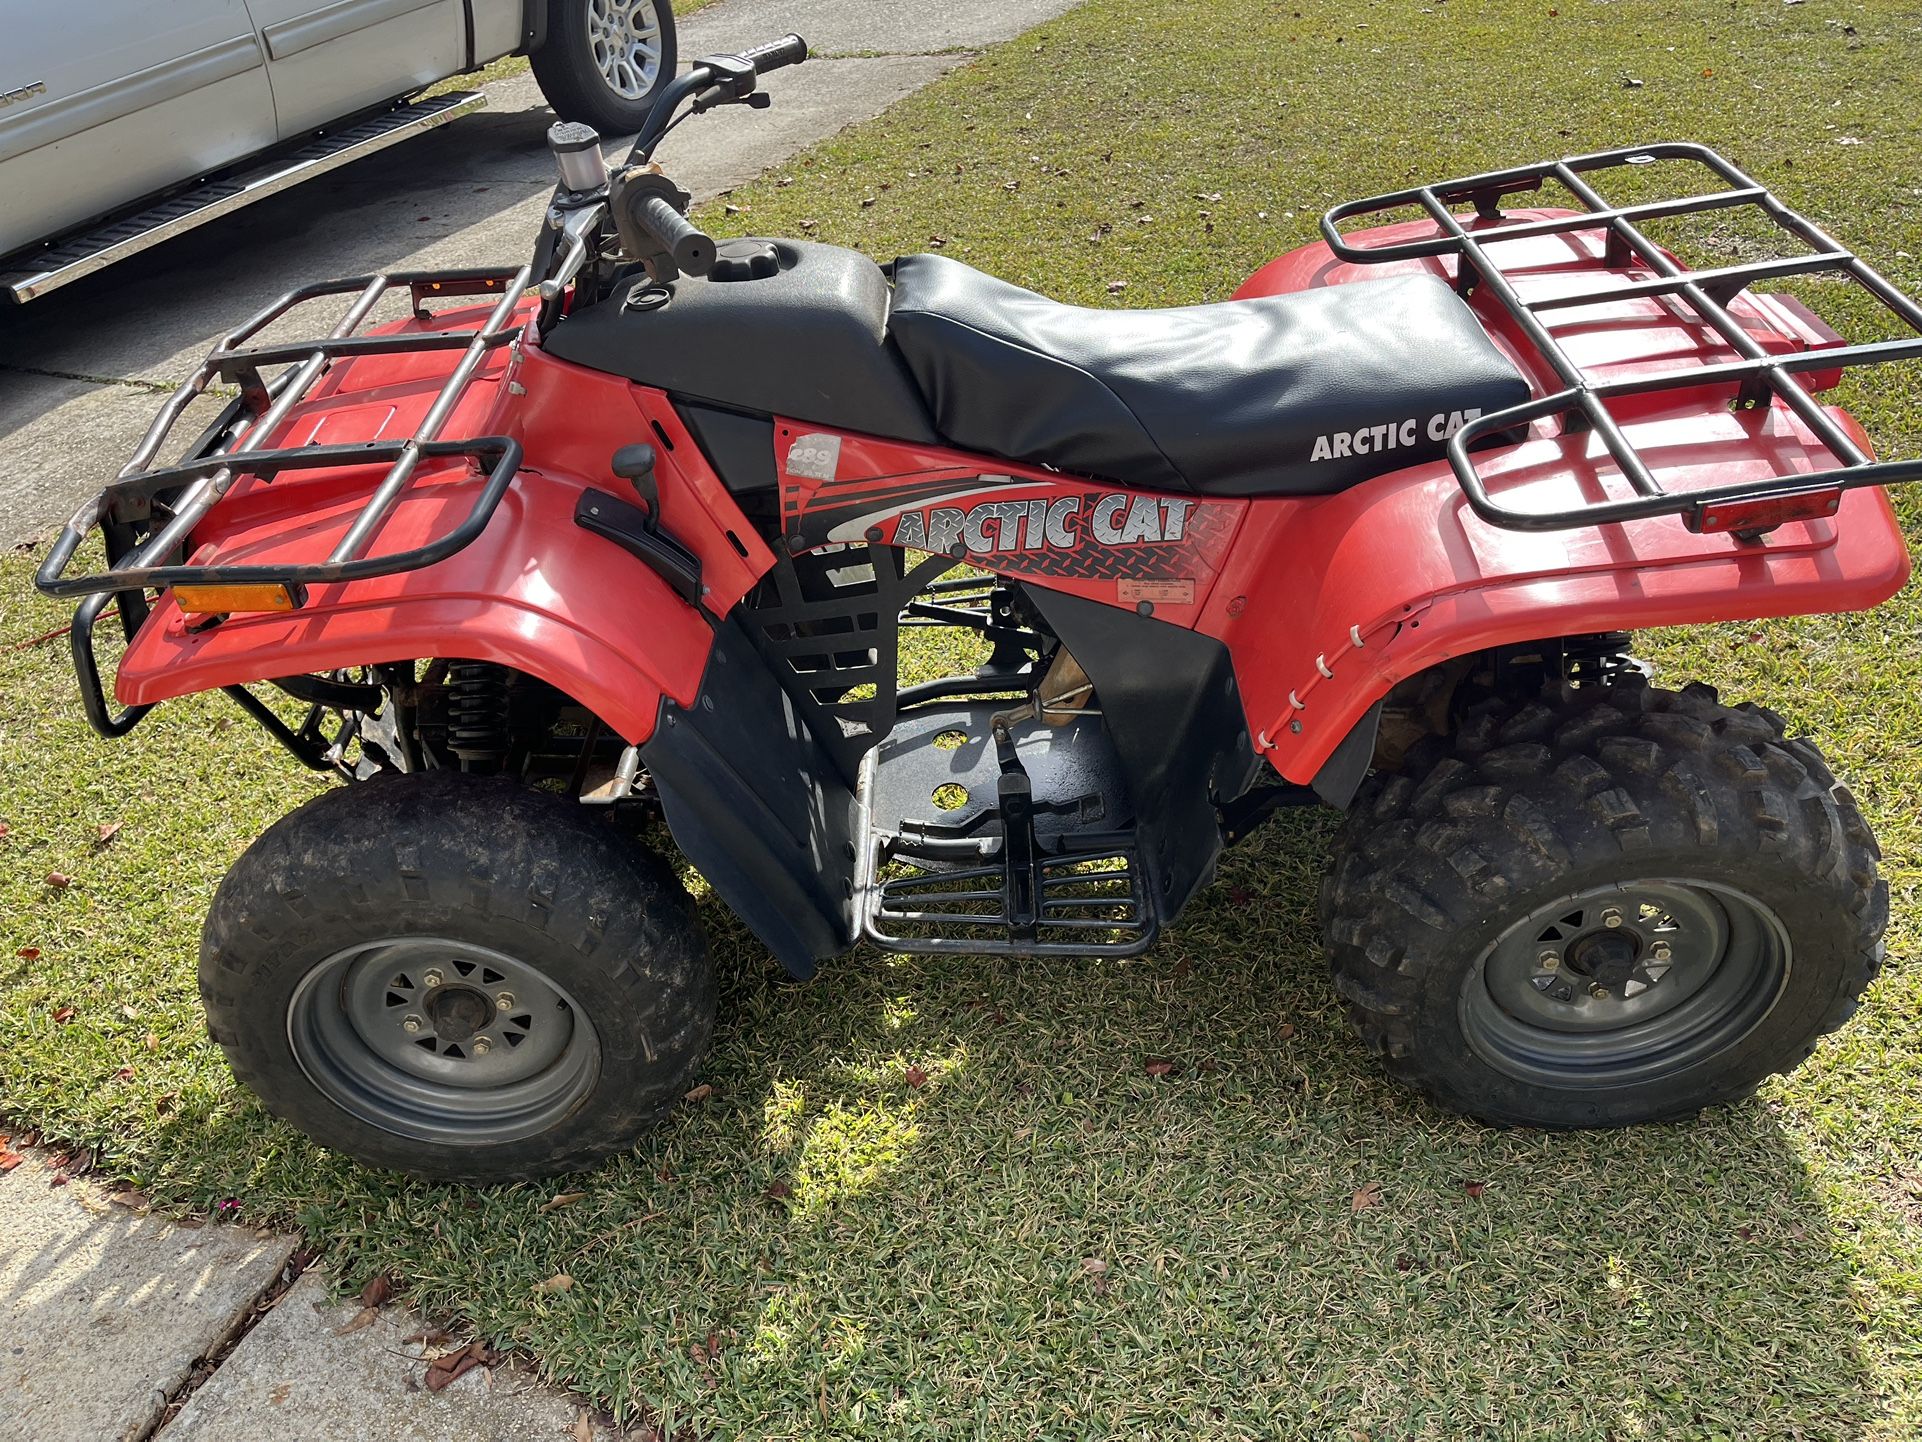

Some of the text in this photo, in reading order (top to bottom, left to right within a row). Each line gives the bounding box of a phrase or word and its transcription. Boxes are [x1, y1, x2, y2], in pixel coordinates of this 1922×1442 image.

[1310, 418, 1416, 462] ARCTIC
[892, 494, 1196, 555] ARCTIC CAT
